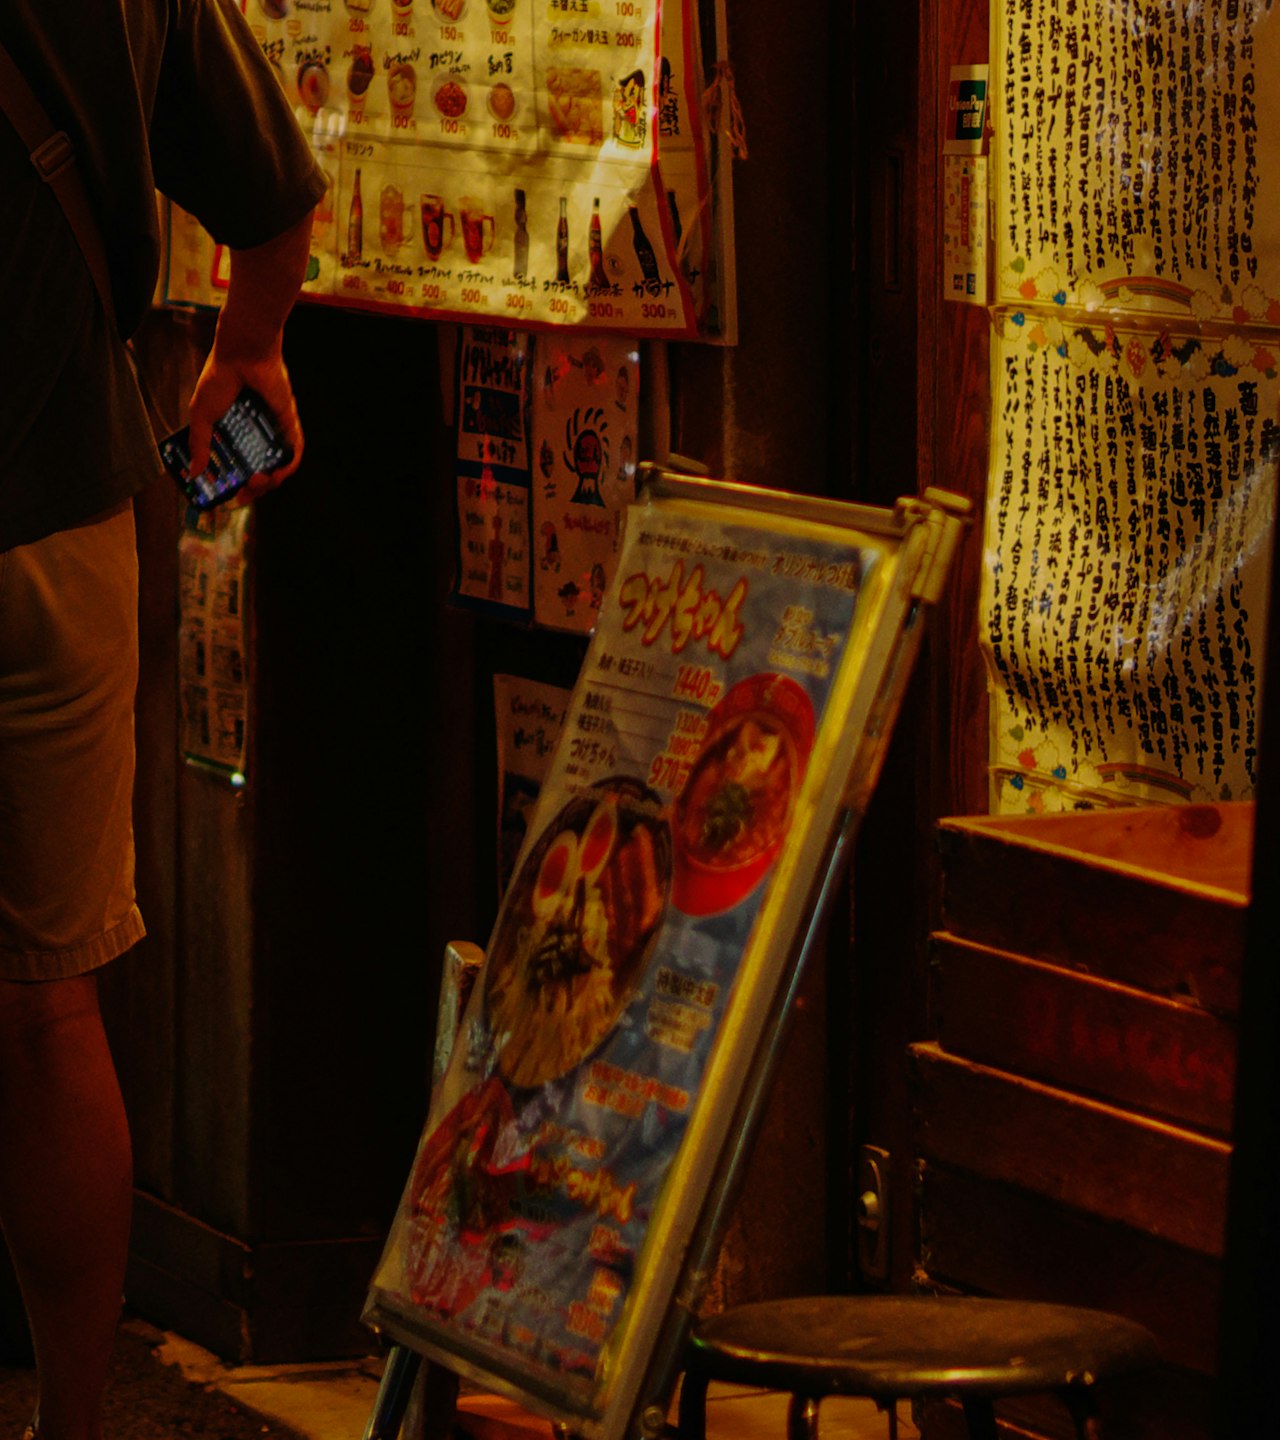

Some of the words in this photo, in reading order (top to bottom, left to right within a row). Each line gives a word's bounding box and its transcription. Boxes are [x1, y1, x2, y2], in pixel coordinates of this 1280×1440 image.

[615, 2, 643, 18] 100円
[439, 25, 466, 42] 150円
[490, 29, 517, 46] 100円
[550, 28, 609, 46] ヴィーガン替え玉
[615, 32, 643, 49] 200円
[440, 118, 467, 135] 100円
[492, 123, 519, 141] 100円
[346, 142, 375, 158] ドリンク
[422, 283, 448, 302] 500円
[461, 288, 489, 305] 500円
[631, 278, 675, 298] ガラナ
[505, 293, 534, 312] 300円
[548, 297, 577, 316] 300円
[589, 301, 625, 319] 300円
[641, 304, 678, 321] 300円
[619, 558, 749, 661] つけちゃん
[673, 665, 721, 702] 1440円
[569, 738, 616, 768] つけちゃん
